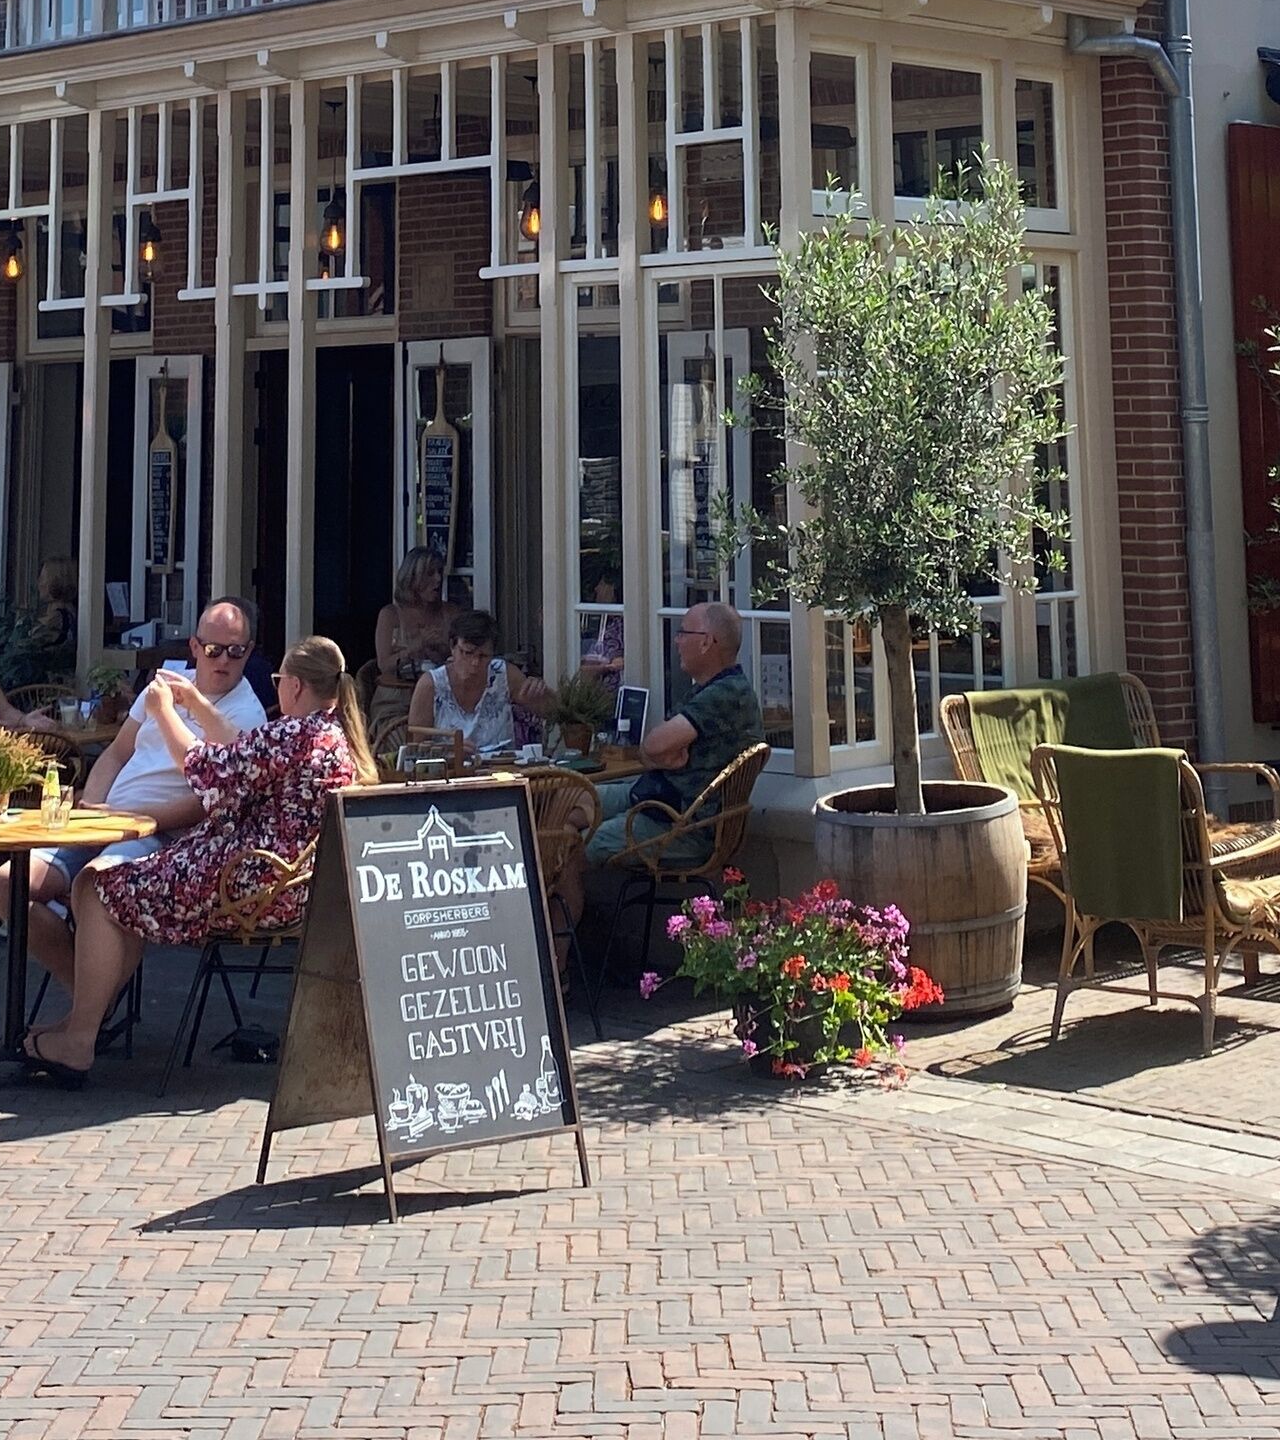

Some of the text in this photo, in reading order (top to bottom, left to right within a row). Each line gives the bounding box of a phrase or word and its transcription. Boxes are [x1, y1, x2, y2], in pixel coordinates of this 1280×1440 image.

[404, 904, 490, 926] DORPSHERBERG
[401, 944, 507, 982] GEWOON
[400, 980, 521, 1023] GEZELLIG
[409, 1016, 526, 1060] GASTVRIJ
